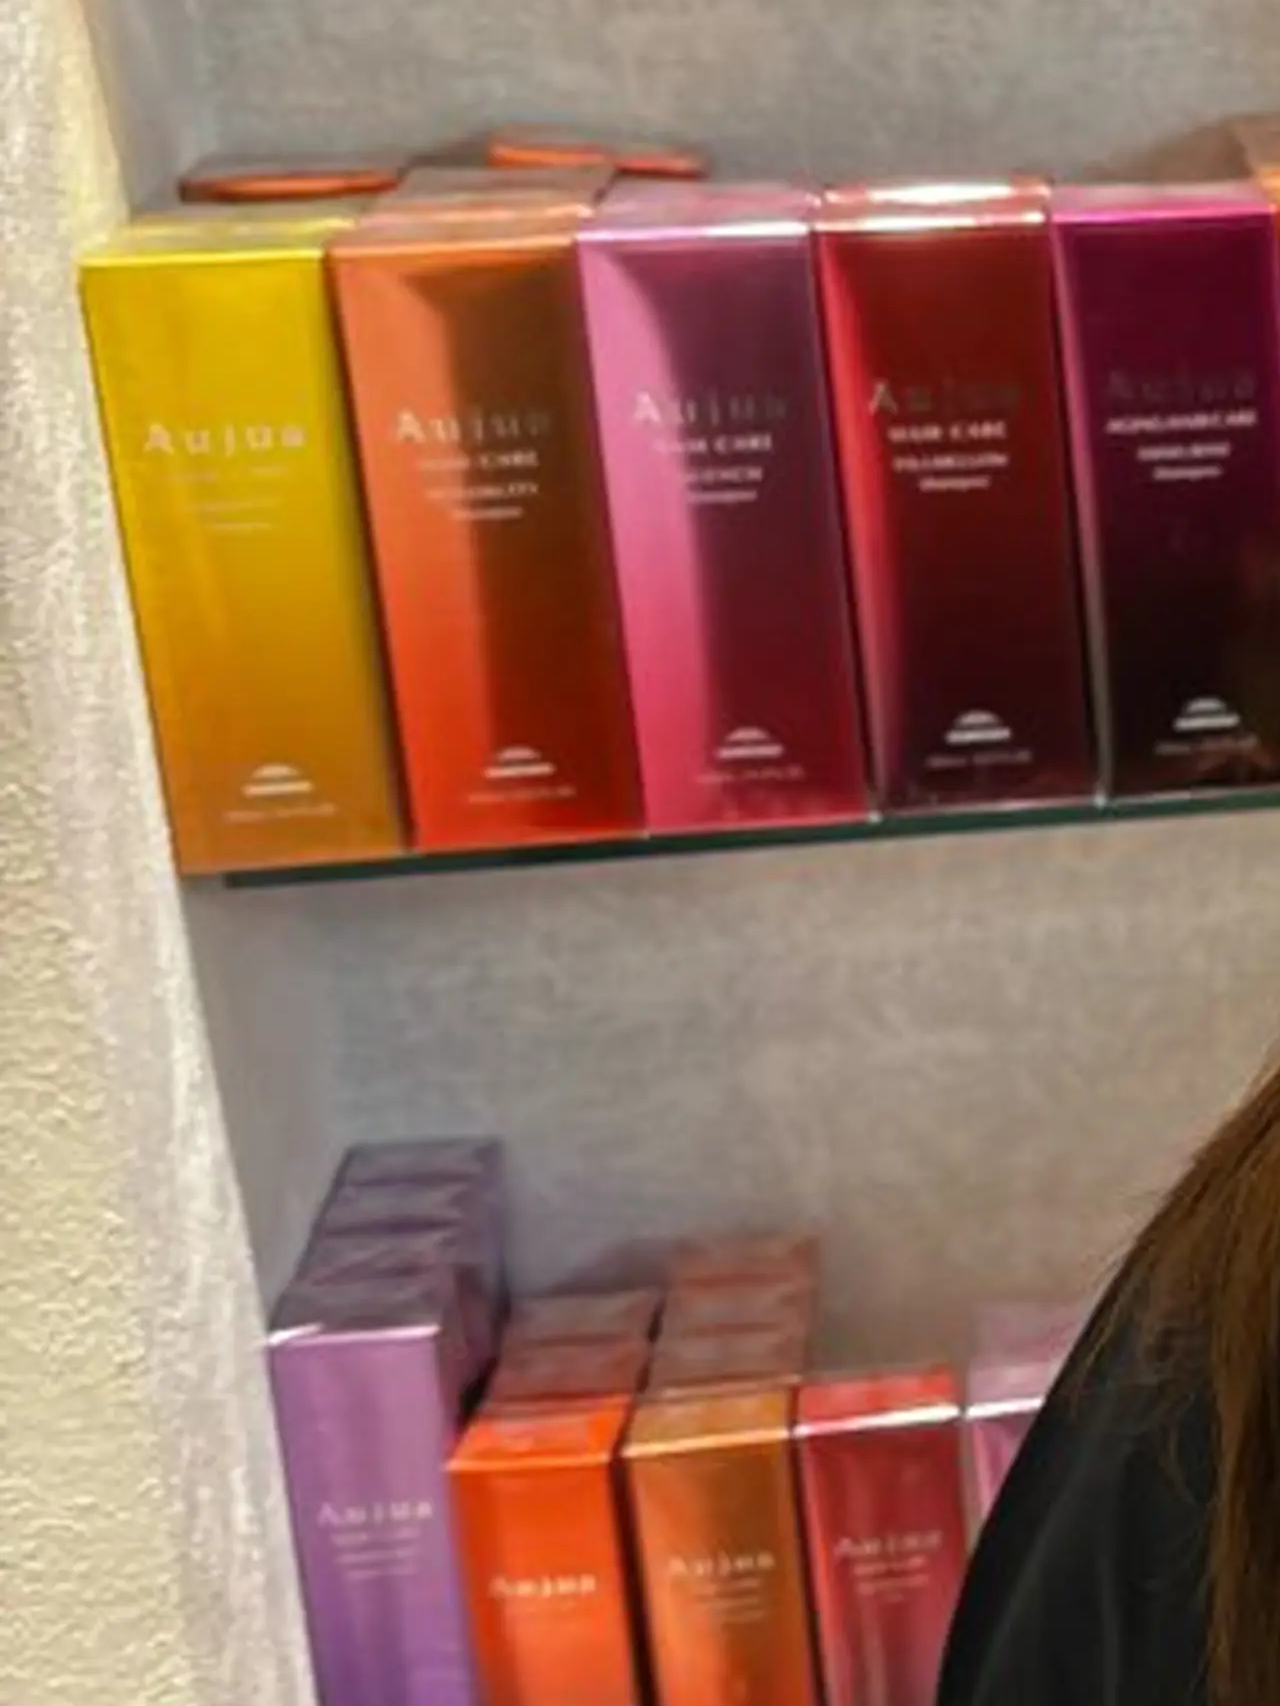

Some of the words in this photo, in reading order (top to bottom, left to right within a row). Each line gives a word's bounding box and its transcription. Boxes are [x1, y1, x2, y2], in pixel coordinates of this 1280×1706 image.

[143, 423, 307, 457] Aujua
[888, 424, 943, 443] HAIR
[950, 420, 1006, 440] CARE
[713, 434, 772, 454] CARE
